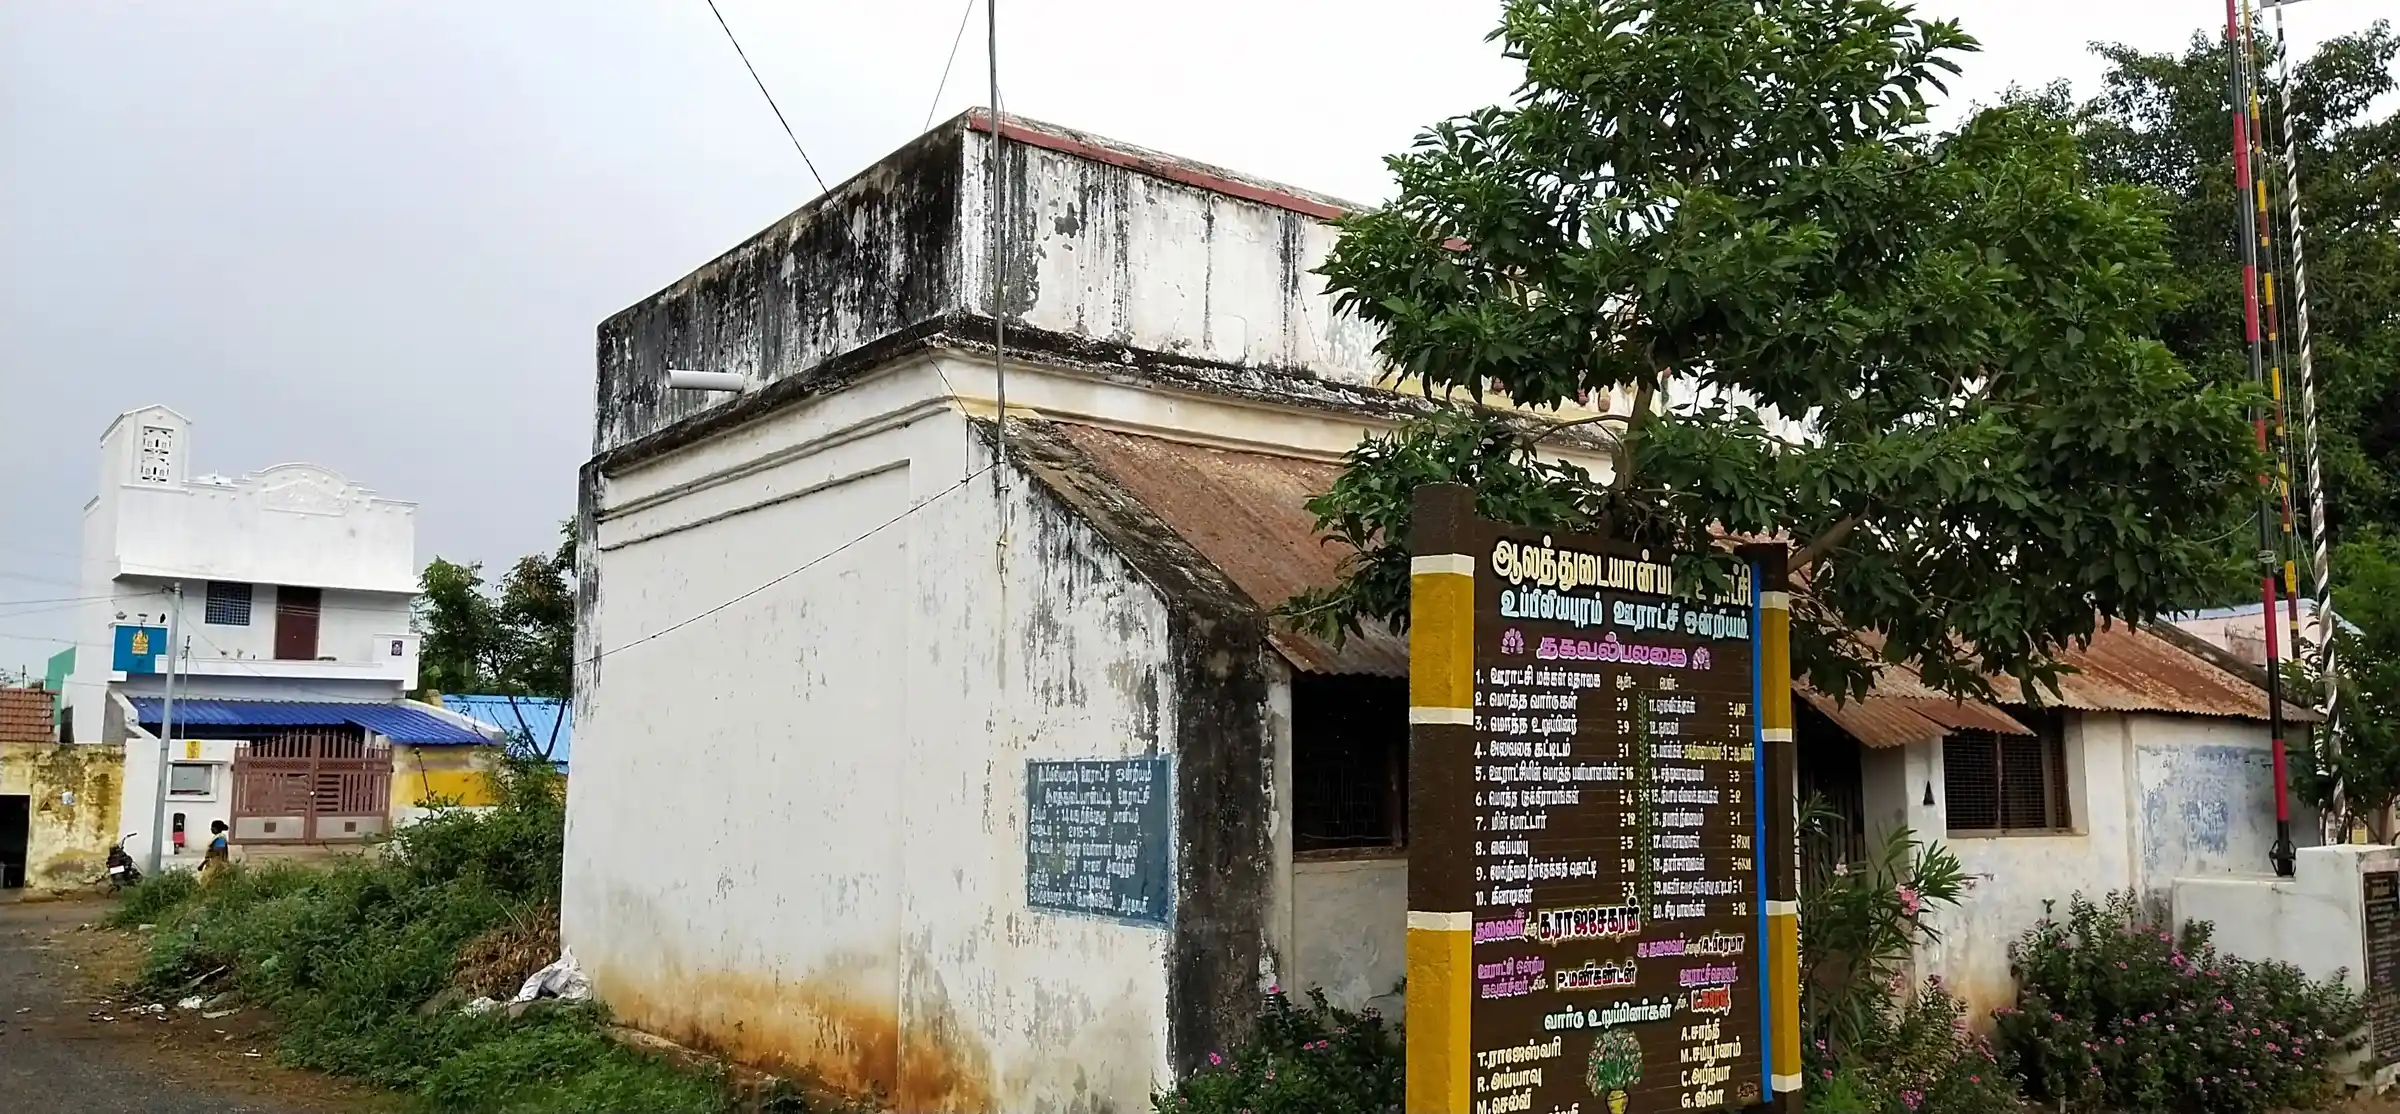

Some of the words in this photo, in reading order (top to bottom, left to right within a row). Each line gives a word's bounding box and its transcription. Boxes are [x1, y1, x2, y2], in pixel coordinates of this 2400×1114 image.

[1501, 585, 1602, 628] உப்பிலியபுரம்
[1614, 600, 1679, 632] ஊராட்சி
[1476, 669, 1484, 684] 1.
[1490, 665, 1533, 687] ஊராட்சி
[1537, 666, 1566, 687] மக்கள்
[1490, 689, 1528, 710] மொத்த
[1530, 691, 1577, 710] வார்டுகள்
[1490, 713, 1528, 735] மொத்த
[1532, 714, 1577, 736] உறுப்பினர்
[1534, 737, 1570, 760] கட்டிடம்
[1543, 762, 1570, 783] மொத்த
[1489, 786, 1518, 809] மொத்த
[1478, 957, 1514, 979] ஊராட்சி
[1544, 1005, 1584, 1030] வார்டு
[1588, 996, 1672, 1029] உறுப்பினர்கள்
[1681, 1018, 1720, 1041] A.சாந்தி
[1477, 1036, 1562, 1069] T.ராஜேஸ்வரி
[1477, 1066, 1542, 1093] R.அய்யாவு
[1477, 1088, 1532, 1114] M.செல்வி
